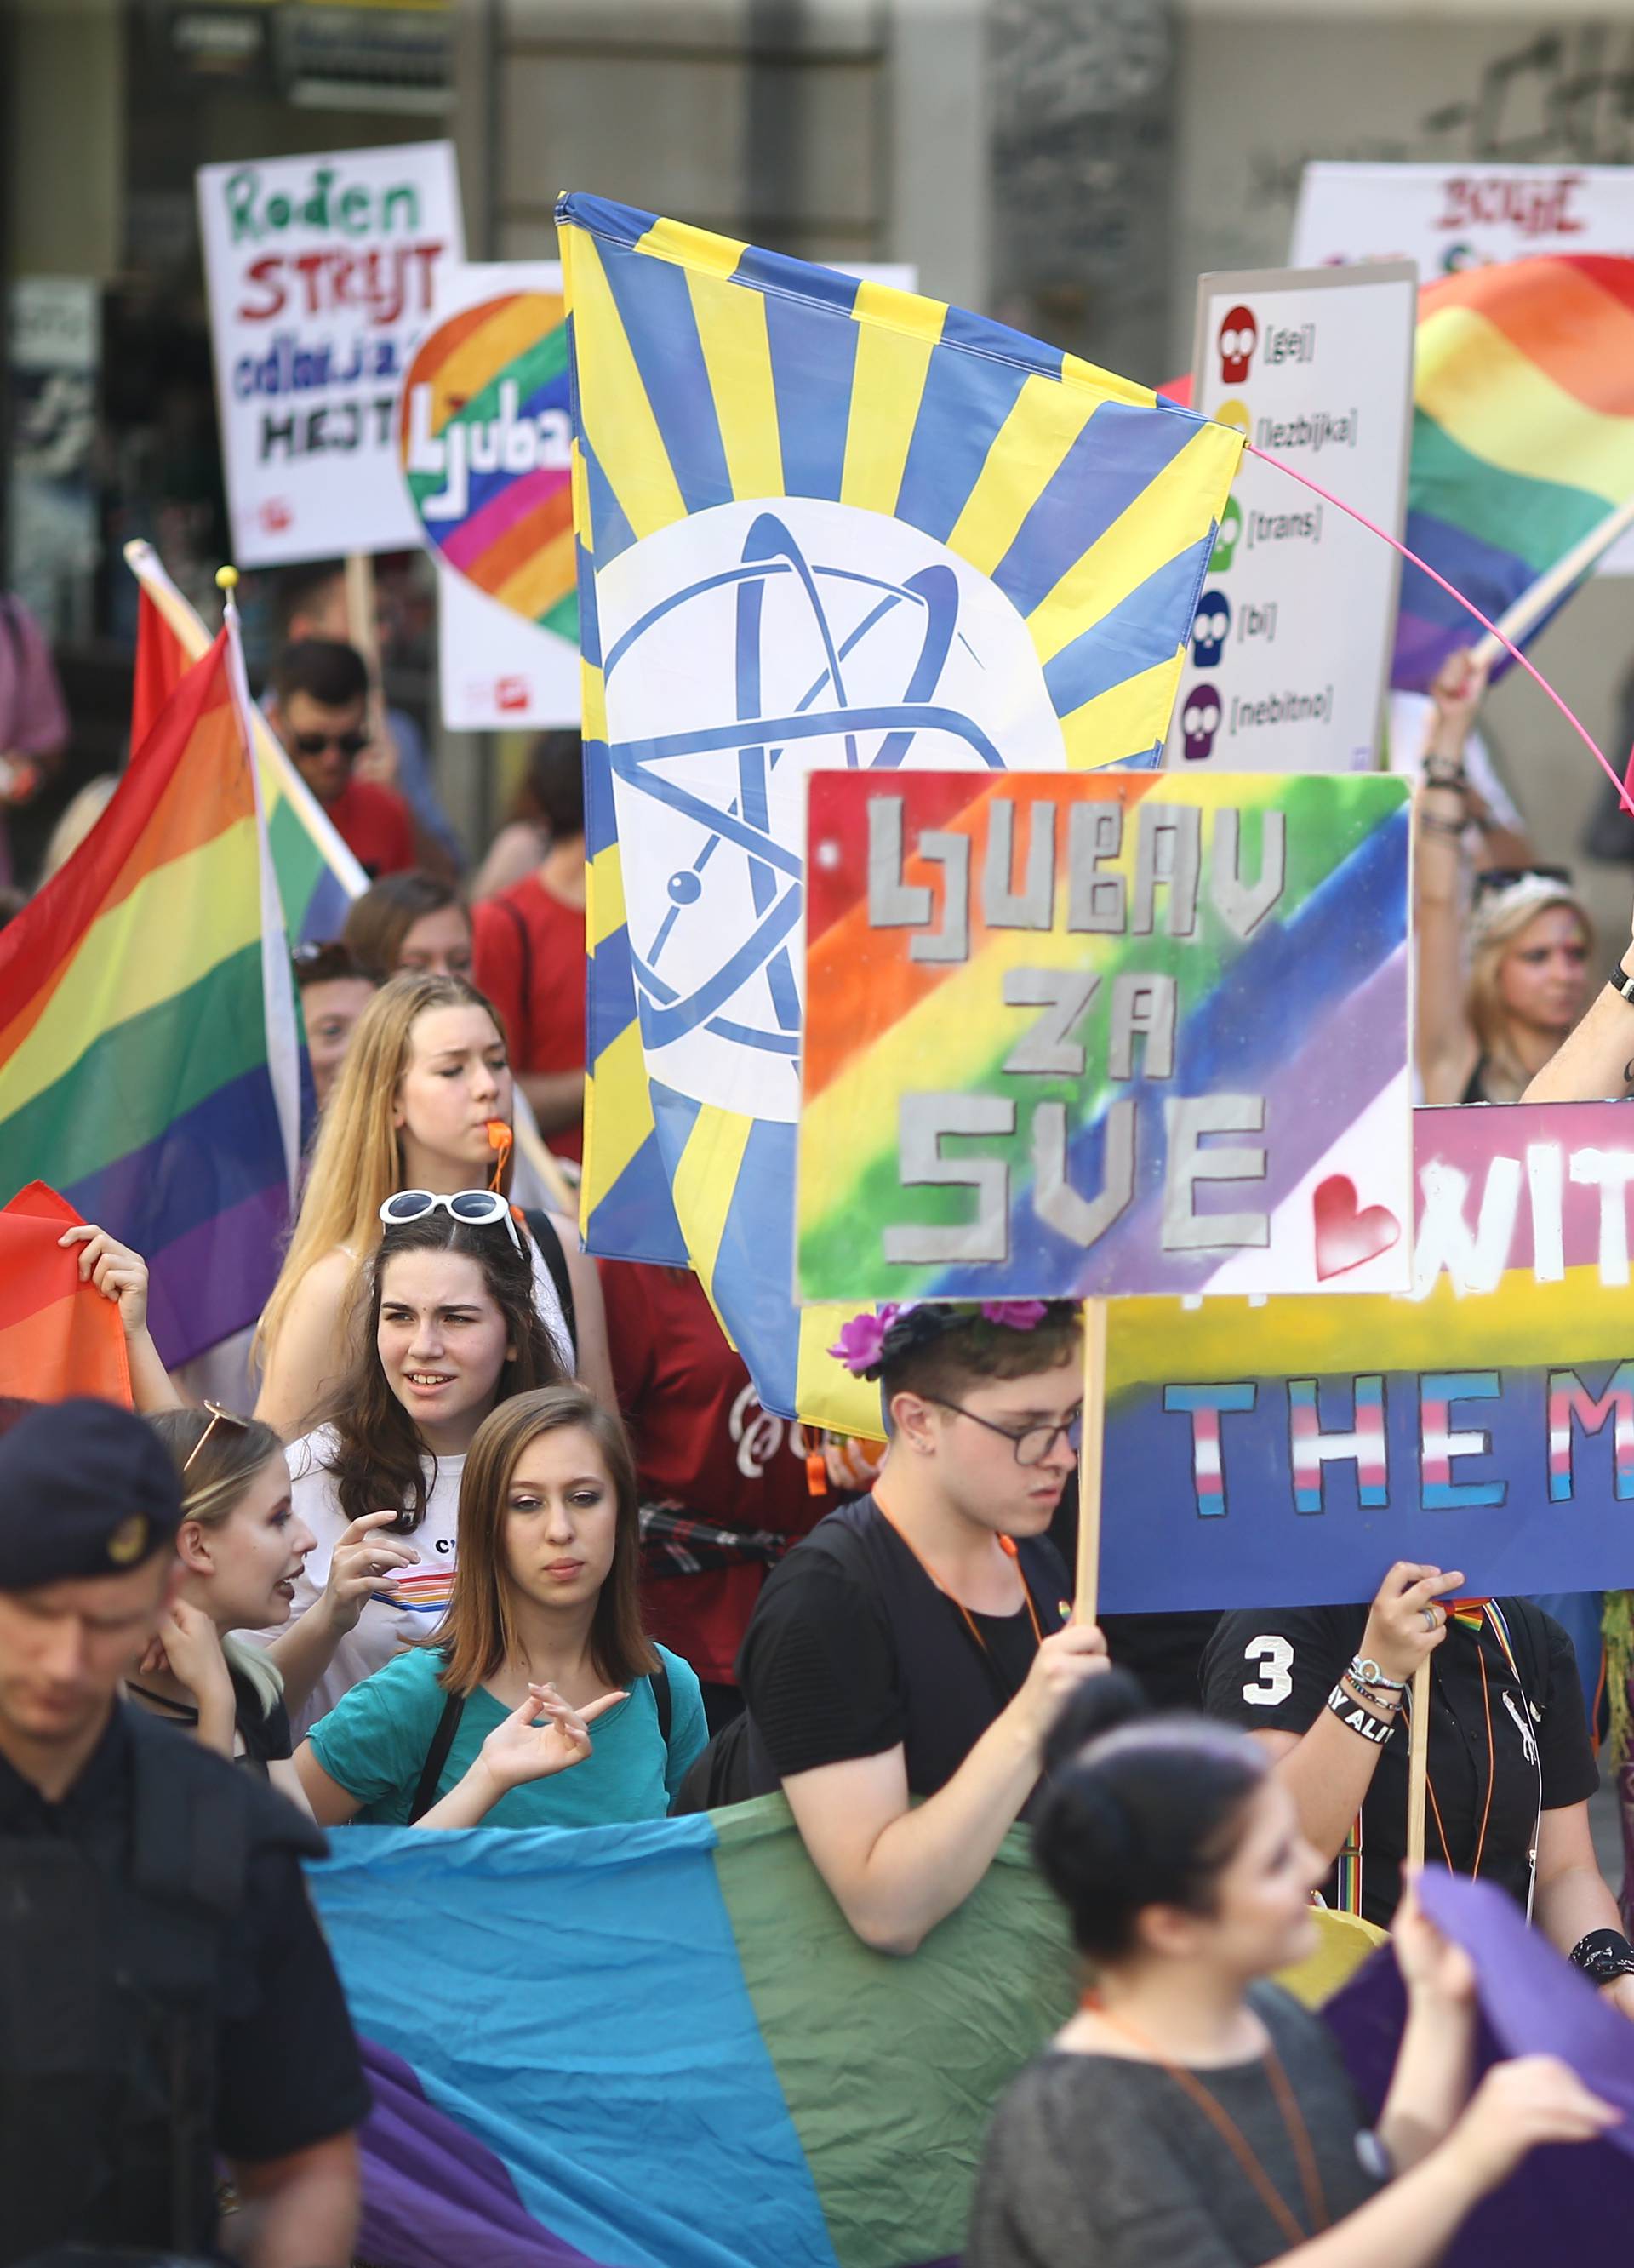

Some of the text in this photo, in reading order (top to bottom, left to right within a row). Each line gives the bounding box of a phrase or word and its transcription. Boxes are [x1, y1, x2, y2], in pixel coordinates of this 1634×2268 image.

[1264, 323, 1315, 365] [gej]
[1256, 408, 1357, 453] [lezbijka]
[1248, 504, 1323, 549] [trans]
[1238, 602, 1277, 643] [bi]
[1231, 684, 1334, 735] [nebitno]
[867, 796, 1286, 963] LJUBAV
[1002, 968, 1177, 1080] ZA
[883, 1093, 1271, 1265] SVE
[1162, 1359, 1634, 1519] THEM
[1243, 1635, 1294, 1706] 3
